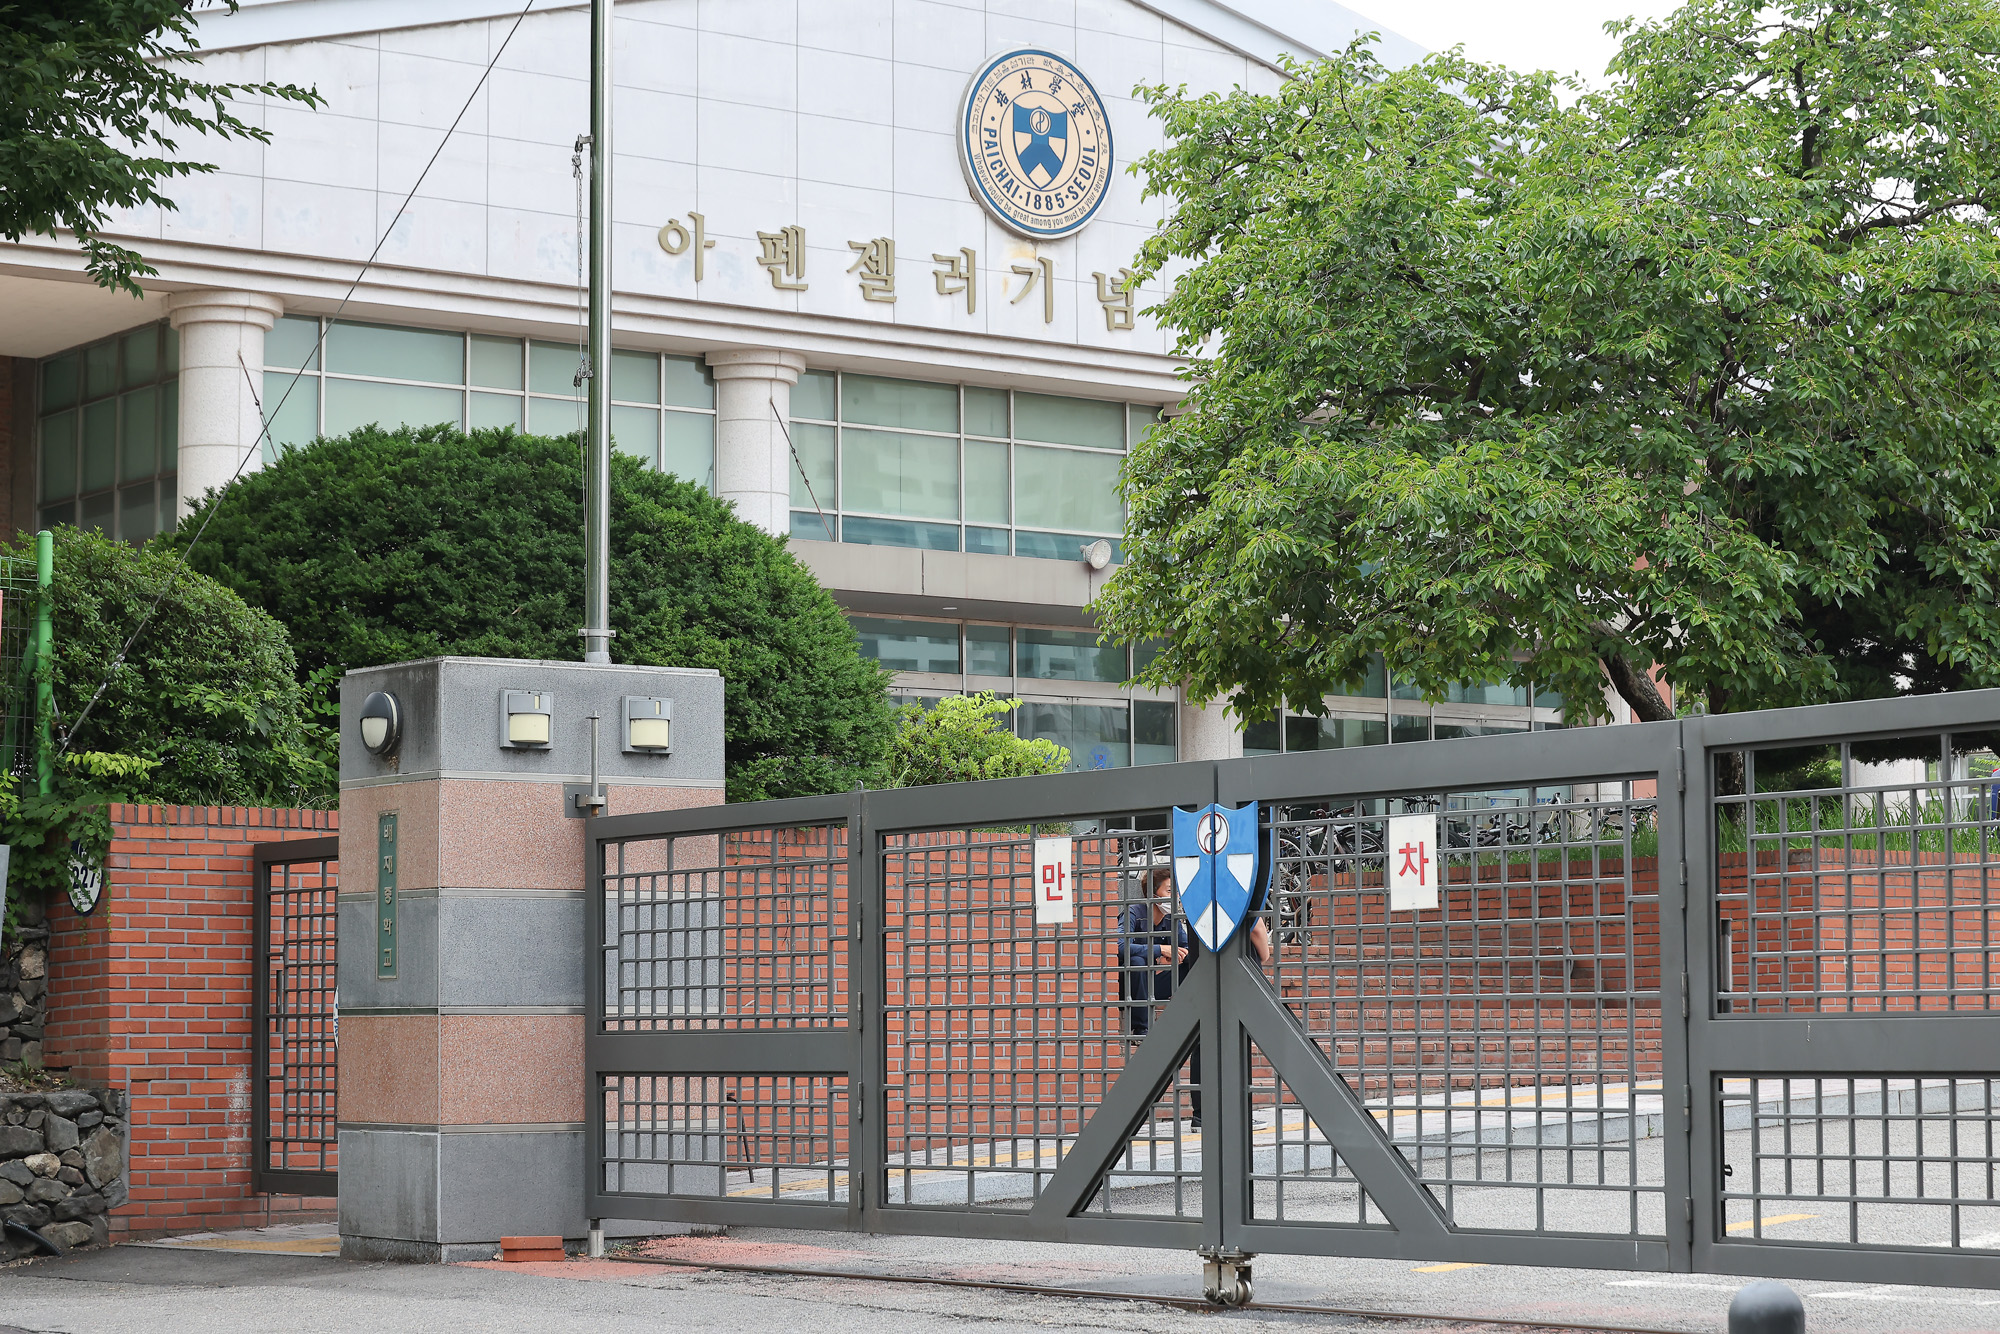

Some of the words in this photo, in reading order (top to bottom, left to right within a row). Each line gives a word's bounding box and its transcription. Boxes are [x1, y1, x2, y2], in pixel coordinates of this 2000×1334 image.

[974, 152, 990, 185] Whoever
[988, 185, 1005, 205] would
[1003, 203, 1012, 213] be
[1012, 210, 1030, 223] great
[1030, 217, 1051, 229] among
[1052, 218, 1064, 229] you
[1064, 210, 1080, 223] must
[1077, 205, 1087, 215] be
[1084, 192, 1096, 209] your
[1093, 167, 1106, 193] servant
[984, 127, 1020, 198] PAICHAI
[1025, 191, 1065, 211] 1885
[1067, 145, 1096, 200] SEOUL
[1042, 861, 1065, 901] 만
[1398, 841, 1430, 886] 차
